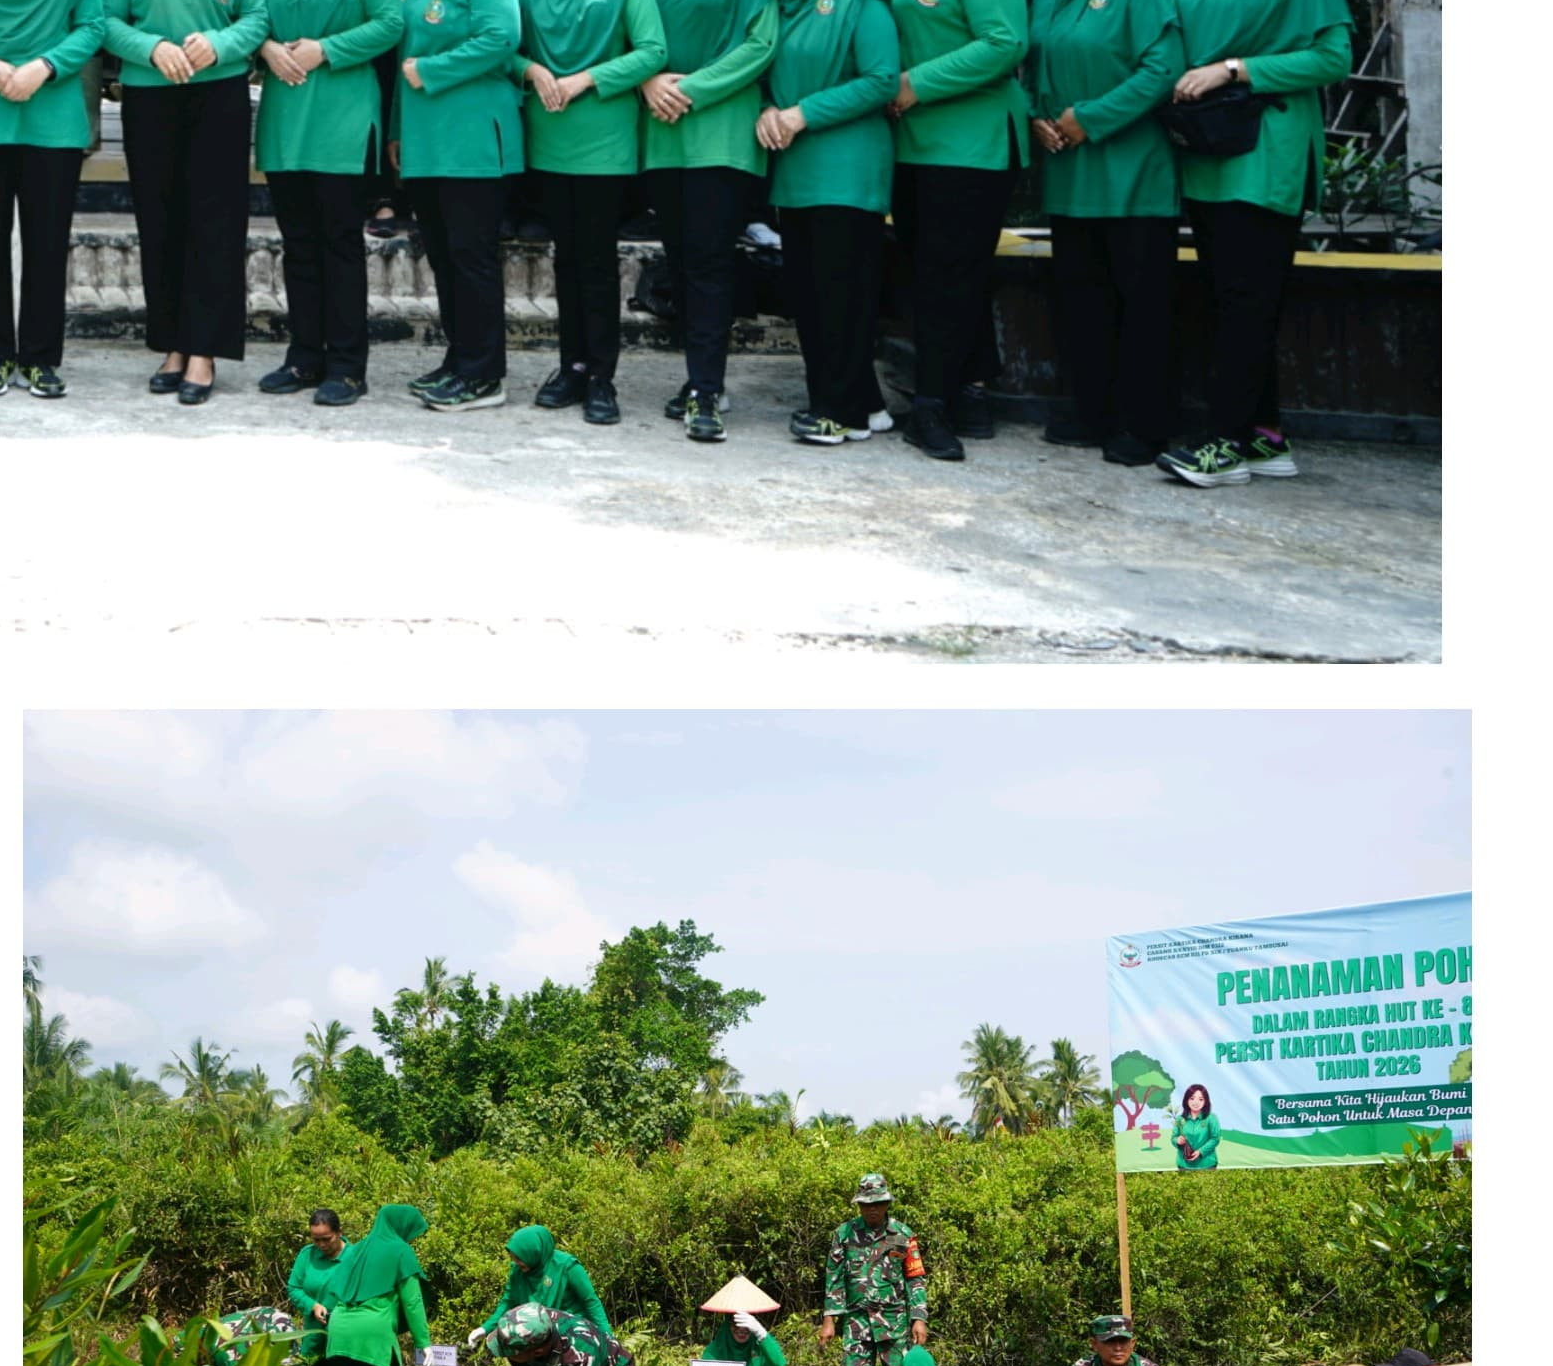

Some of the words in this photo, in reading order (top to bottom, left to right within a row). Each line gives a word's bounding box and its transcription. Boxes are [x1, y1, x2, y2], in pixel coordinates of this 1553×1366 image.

[1217, 954, 1404, 1006] PENANAMAN
[1414, 945, 1472, 988] POH
[1252, 1011, 1309, 1034] DALAM
[1313, 1005, 1379, 1029] RANGKA
[1384, 1000, 1417, 1023] HUT
[1422, 998, 1444, 1020] KE
[1215, 1039, 1274, 1064] PERSIT
[1279, 1033, 1356, 1059] KARTIKA
[1361, 1024, 1452, 1053] CHANDRA
[1315, 1058, 1369, 1081] TAHUN
[1374, 1054, 1421, 1077] 2026
[1267, 1113, 1296, 1125] Satu
[1297, 1111, 1341, 1124] Pohon
[1343, 1107, 1383, 1121] Untuk
[1386, 1106, 1424, 1119] Masa
[1427, 1104, 1472, 1121] Depan
[1275, 1097, 1332, 1110] Bersama
[1334, 1094, 1362, 1107] Kita
[1365, 1091, 1426, 1114] Hijaukan
[1429, 1087, 1467, 1101] Bumi
